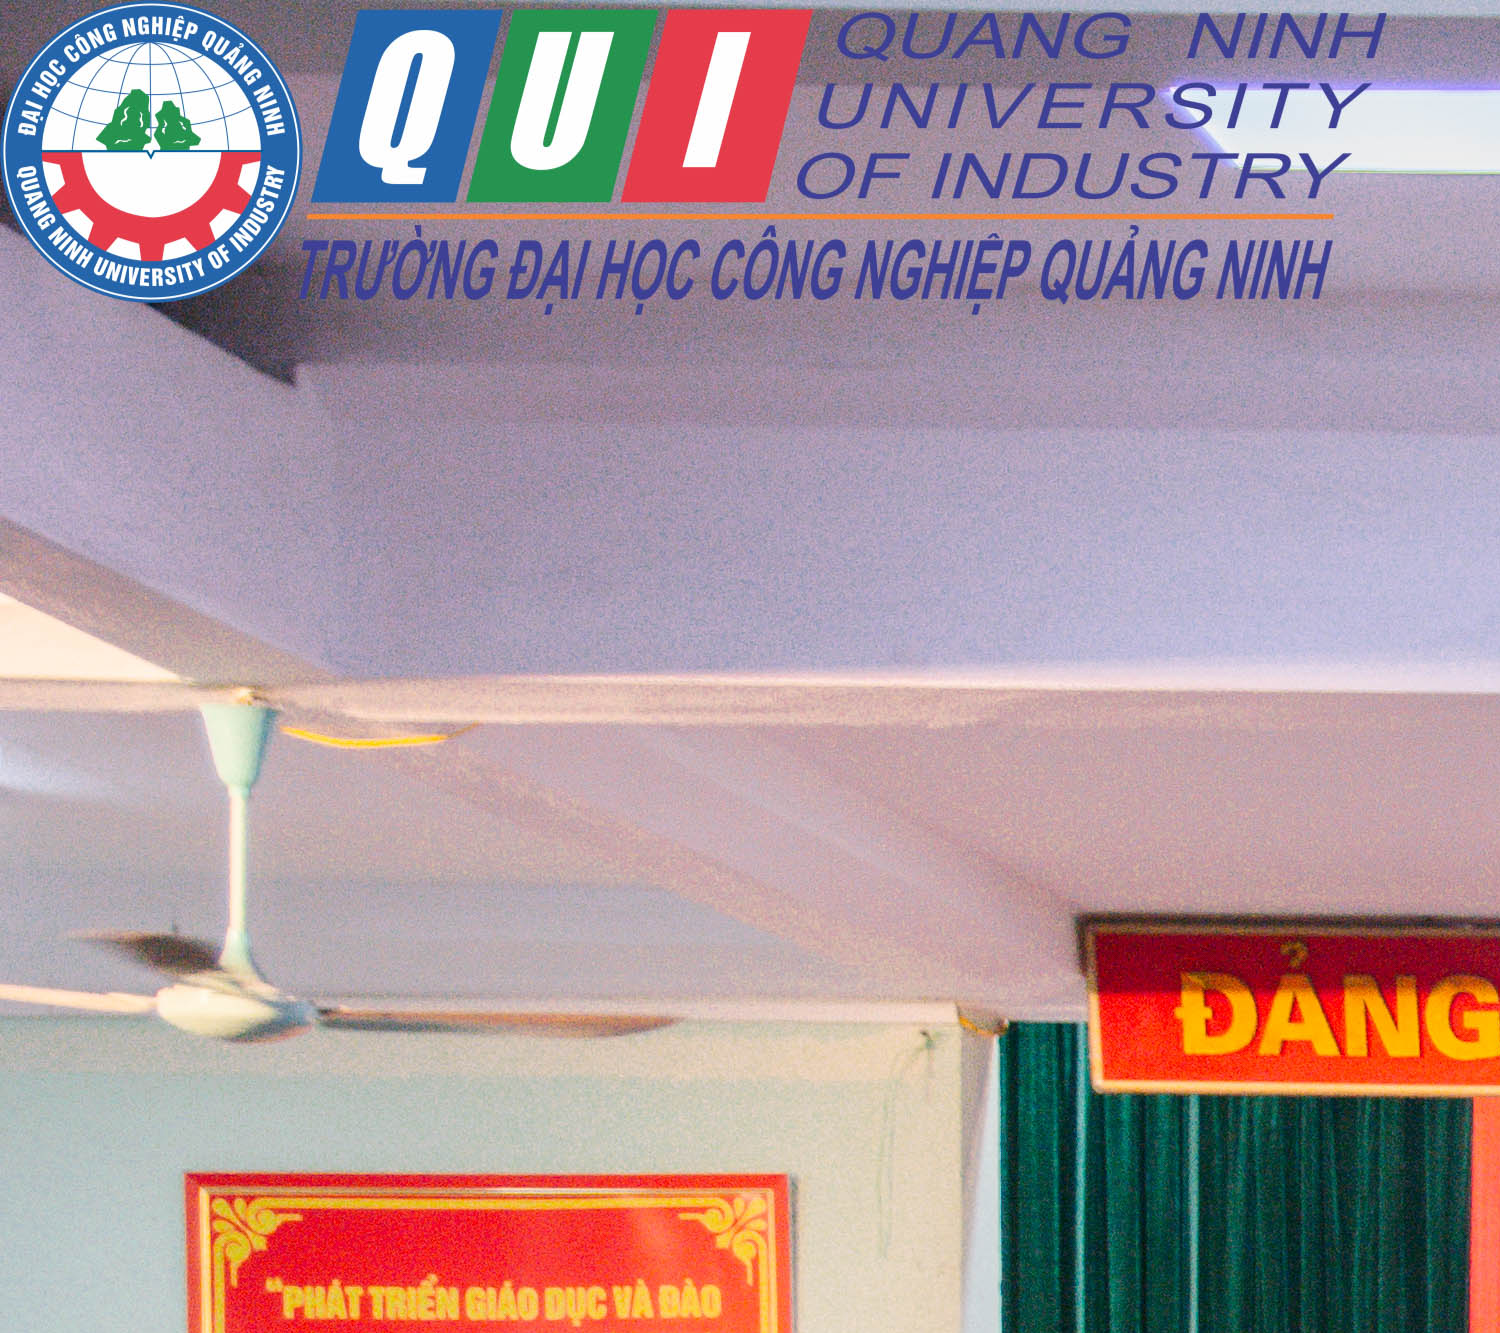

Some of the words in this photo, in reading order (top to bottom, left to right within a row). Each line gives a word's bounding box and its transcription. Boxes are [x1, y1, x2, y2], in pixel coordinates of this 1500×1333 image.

[368, 1276, 460, 1320] TRIỂN
[465, 1281, 538, 1321] GIÁO
[544, 1287, 606, 1325] DỤC
[613, 1280, 653, 1319] VÀ
[658, 1277, 722, 1321] ĐÀO
